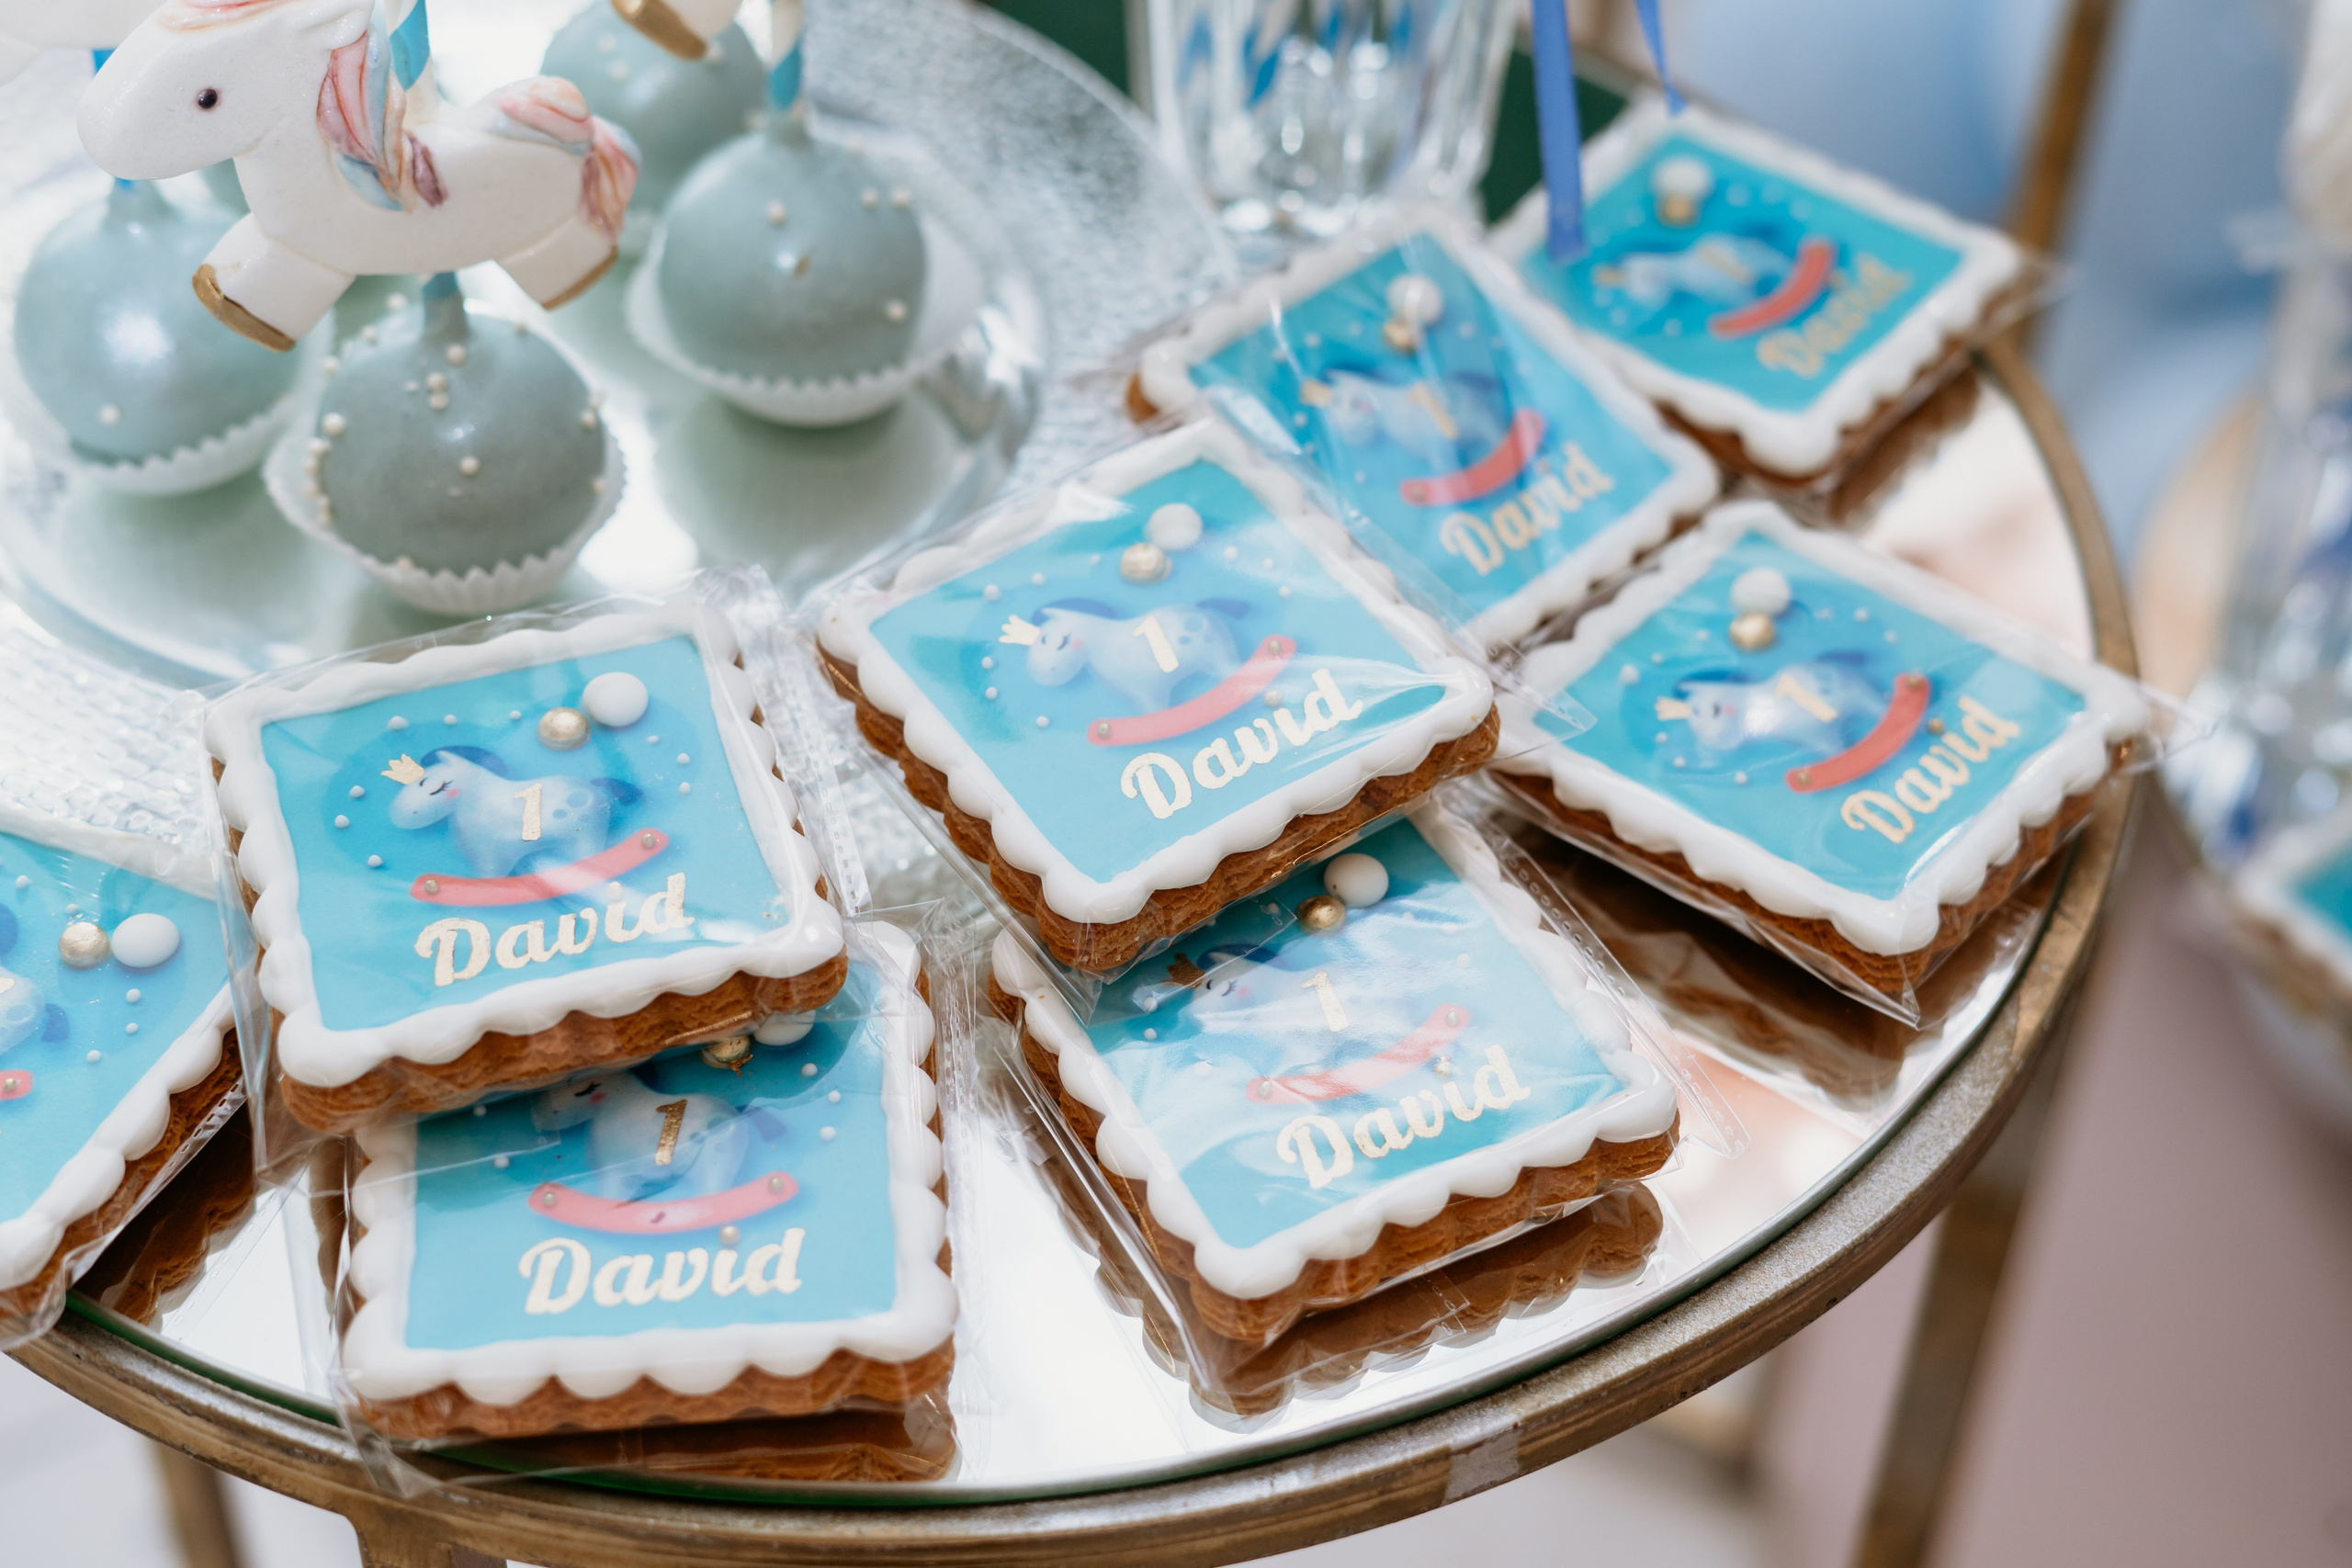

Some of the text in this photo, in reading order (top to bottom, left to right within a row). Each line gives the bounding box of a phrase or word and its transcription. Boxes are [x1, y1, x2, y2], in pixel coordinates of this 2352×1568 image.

[1408, 381, 1460, 439] 1
[1439, 441, 1615, 575] David
[1133, 615, 1180, 673] 1
[1776, 674, 1838, 723] 1
[1120, 668, 1363, 819] David
[1840, 695, 2020, 844] David
[514, 784, 542, 841] 1
[414, 872, 695, 987] David
[1301, 970, 1349, 1032] 1
[655, 1099, 689, 1166] 1
[1276, 1043, 1532, 1189] David
[519, 1227, 805, 1315] David
